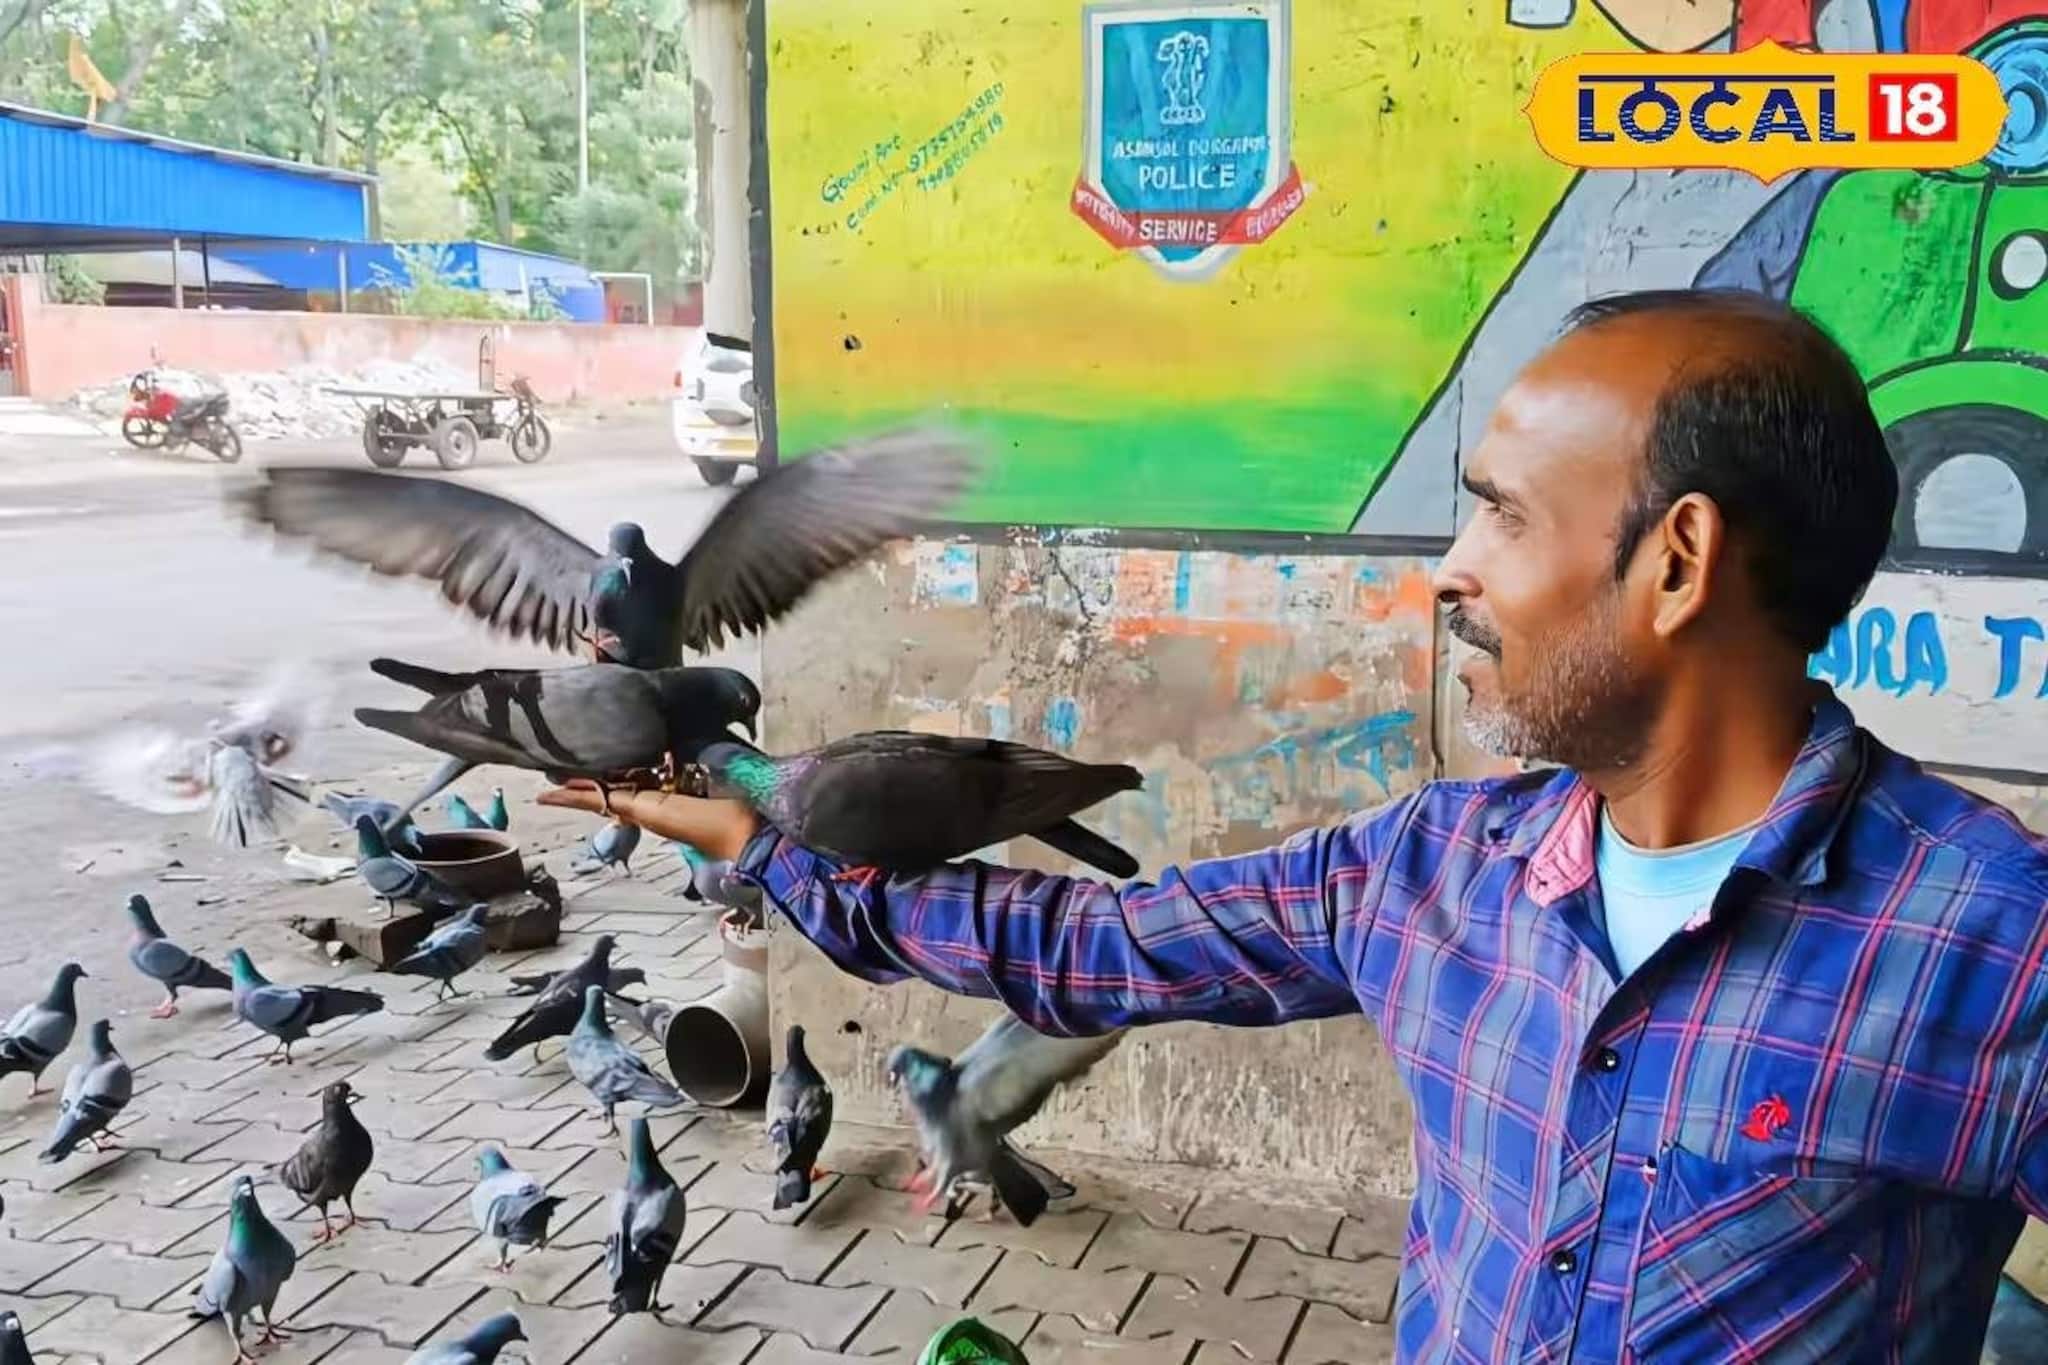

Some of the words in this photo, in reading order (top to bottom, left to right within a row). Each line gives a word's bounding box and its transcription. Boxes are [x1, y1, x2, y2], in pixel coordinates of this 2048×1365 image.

[1139, 163, 1236, 191] POLICE
[1139, 218, 1219, 242] SERVICE
[1984, 614, 2048, 699] T
